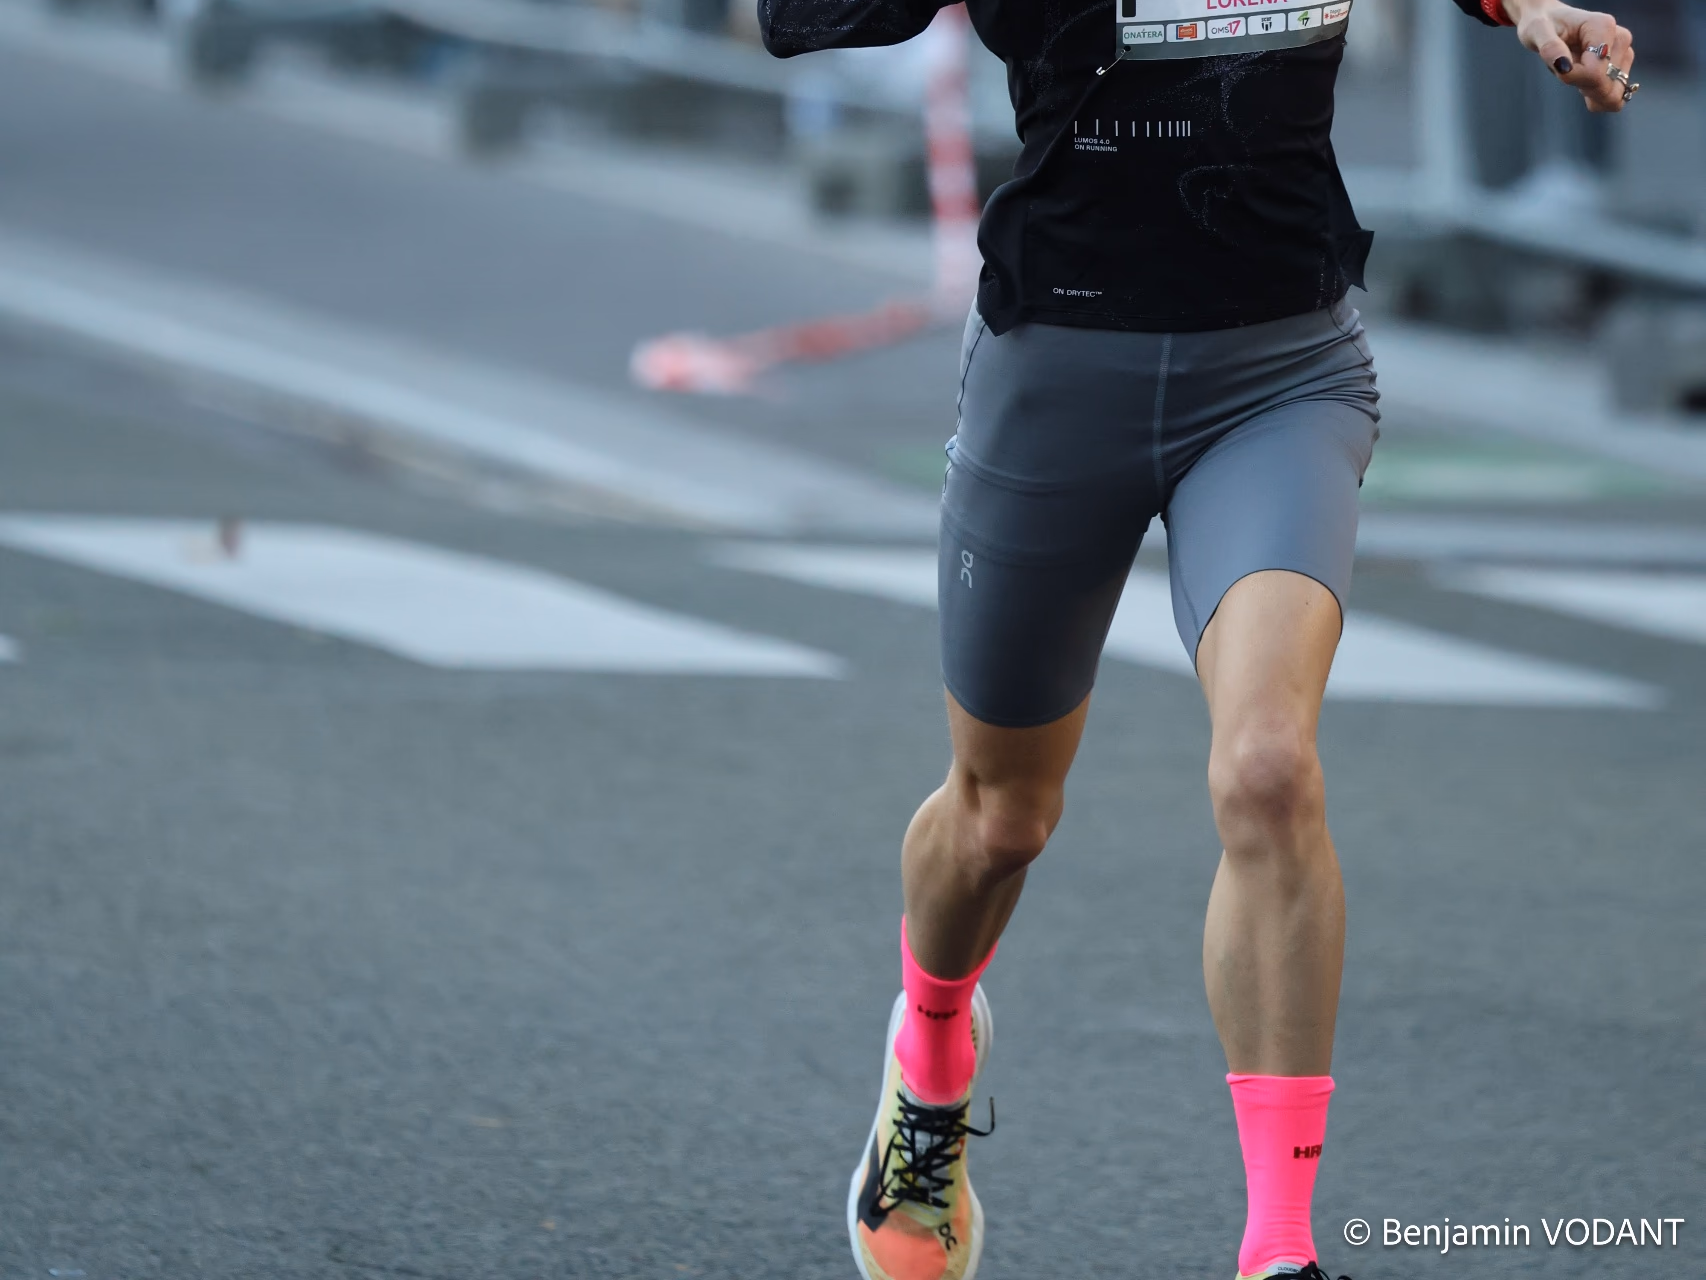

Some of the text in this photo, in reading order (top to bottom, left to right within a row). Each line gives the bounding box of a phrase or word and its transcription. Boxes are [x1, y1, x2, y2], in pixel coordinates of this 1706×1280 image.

[1123, 28, 1163, 40] ONATERA
[1074, 137, 1098, 145] LUMOS
[1052, 287, 1064, 295] ON
